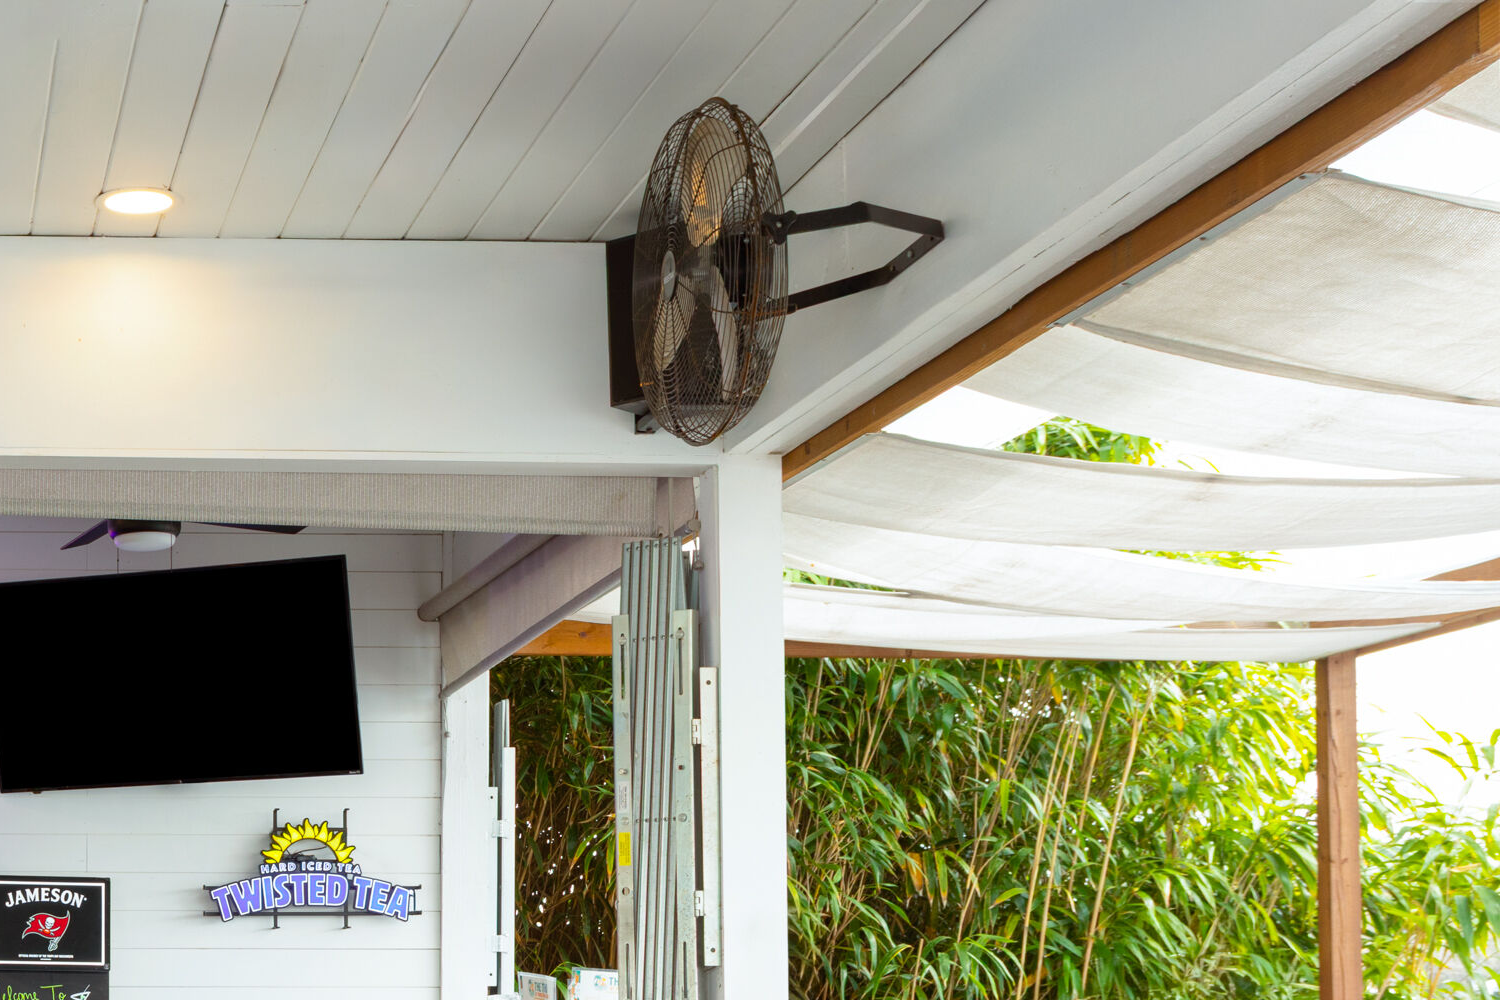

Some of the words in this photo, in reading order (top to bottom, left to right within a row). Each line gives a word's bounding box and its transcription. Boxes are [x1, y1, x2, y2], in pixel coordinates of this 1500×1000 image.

[260, 862, 297, 874] HARD
[301, 862, 332, 872] ICED
[338, 862, 361, 875] TEA
[4, 887, 84, 909] JAMESON
[211, 872, 349, 922] TWISTED
[353, 876, 410, 921] TEA
